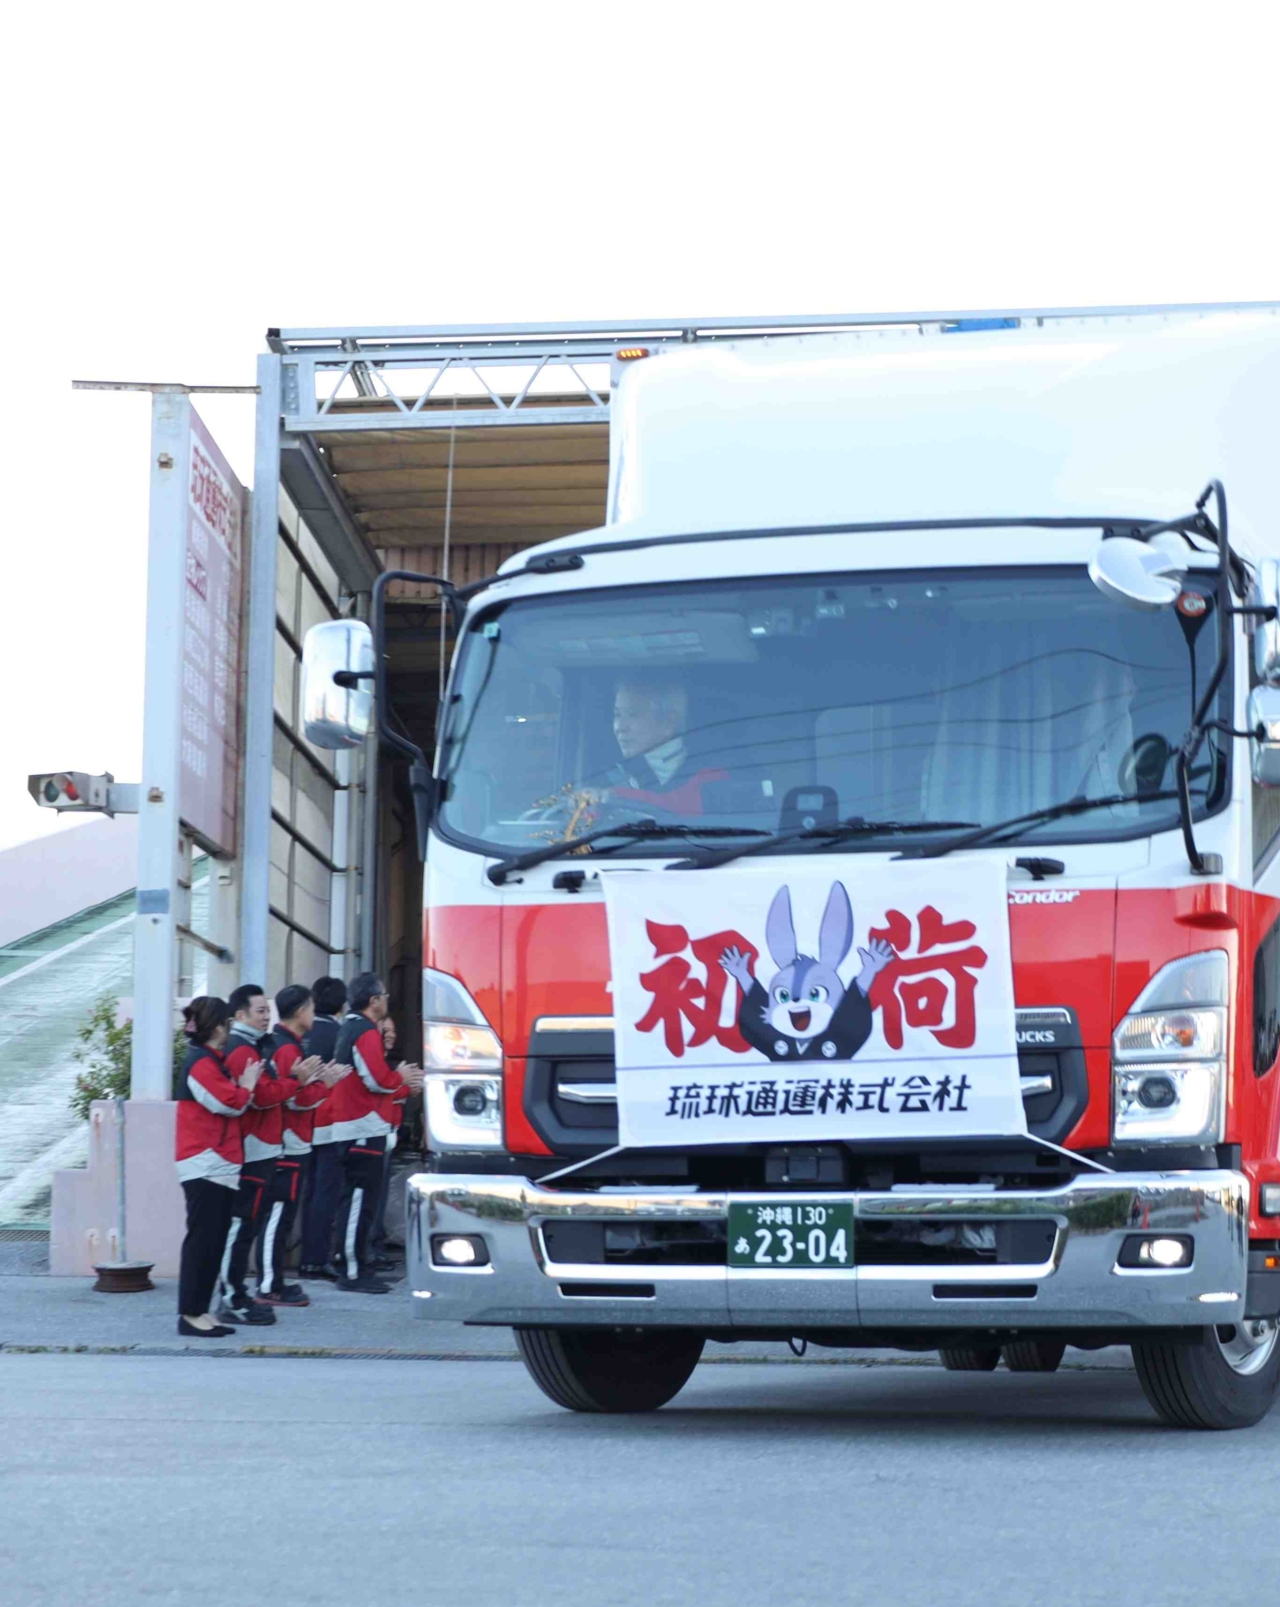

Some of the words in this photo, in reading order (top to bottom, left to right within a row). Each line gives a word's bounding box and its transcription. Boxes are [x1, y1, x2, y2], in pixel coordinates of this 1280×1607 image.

[635, 906, 988, 1058] 初荷
[664, 1075, 971, 1120] 琉球通運株式会社
[734, 1236, 750, 1254] あ
[754, 1228, 848, 1263] 23-04
